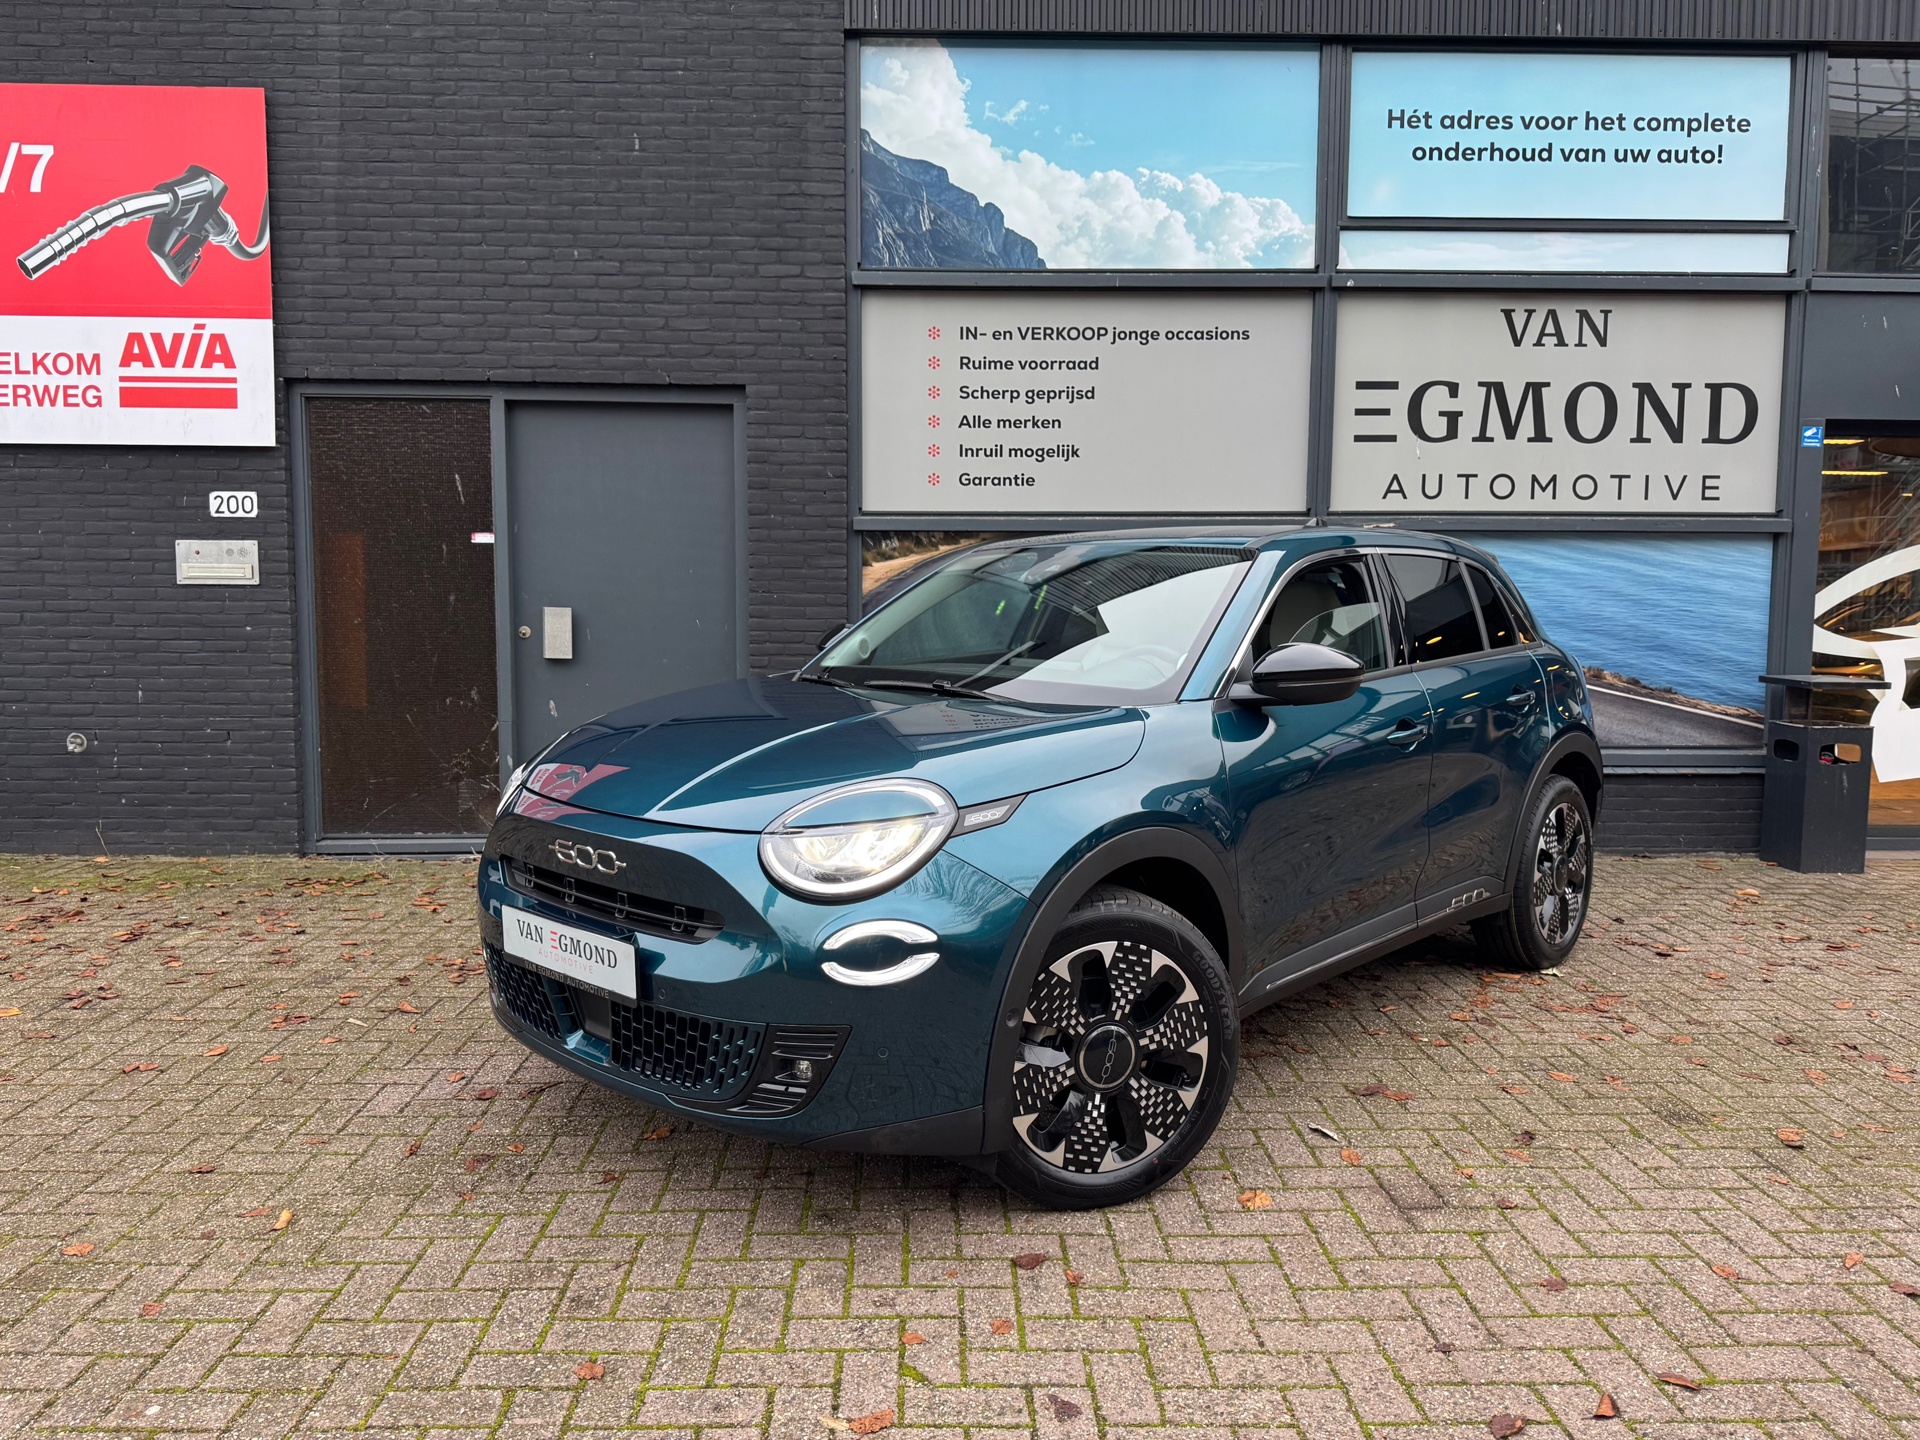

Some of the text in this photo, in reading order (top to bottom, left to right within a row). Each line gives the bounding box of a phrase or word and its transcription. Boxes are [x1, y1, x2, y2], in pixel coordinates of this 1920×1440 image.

[1387, 108, 1751, 138] Hét adres voor het complete
[1411, 141, 1723, 165] onderhoud van uw auto!
[959, 326, 1250, 346] IN- en VERKOOP jonge occasions
[1500, 308, 1613, 348] VAN
[959, 355, 1099, 371] Ruime voorraad
[959, 385, 1095, 404] Scherp geprijsd
[958, 414, 1062, 429] Alle merken
[1353, 380, 1759, 445] EGMOND
[959, 443, 1081, 462] Inruil mogelijk
[958, 472, 1036, 487] Garantie
[1381, 473, 1721, 501] AUTOMOTIVE
[213, 495, 254, 514] 200
[550, 839, 626, 875] 600
[516, 918, 618, 969] VAN EGMOND
[538, 947, 594, 974] AUTOMOTIVE
[524, 960, 610, 999] VAN EGMOND AUTOMOTIVE
